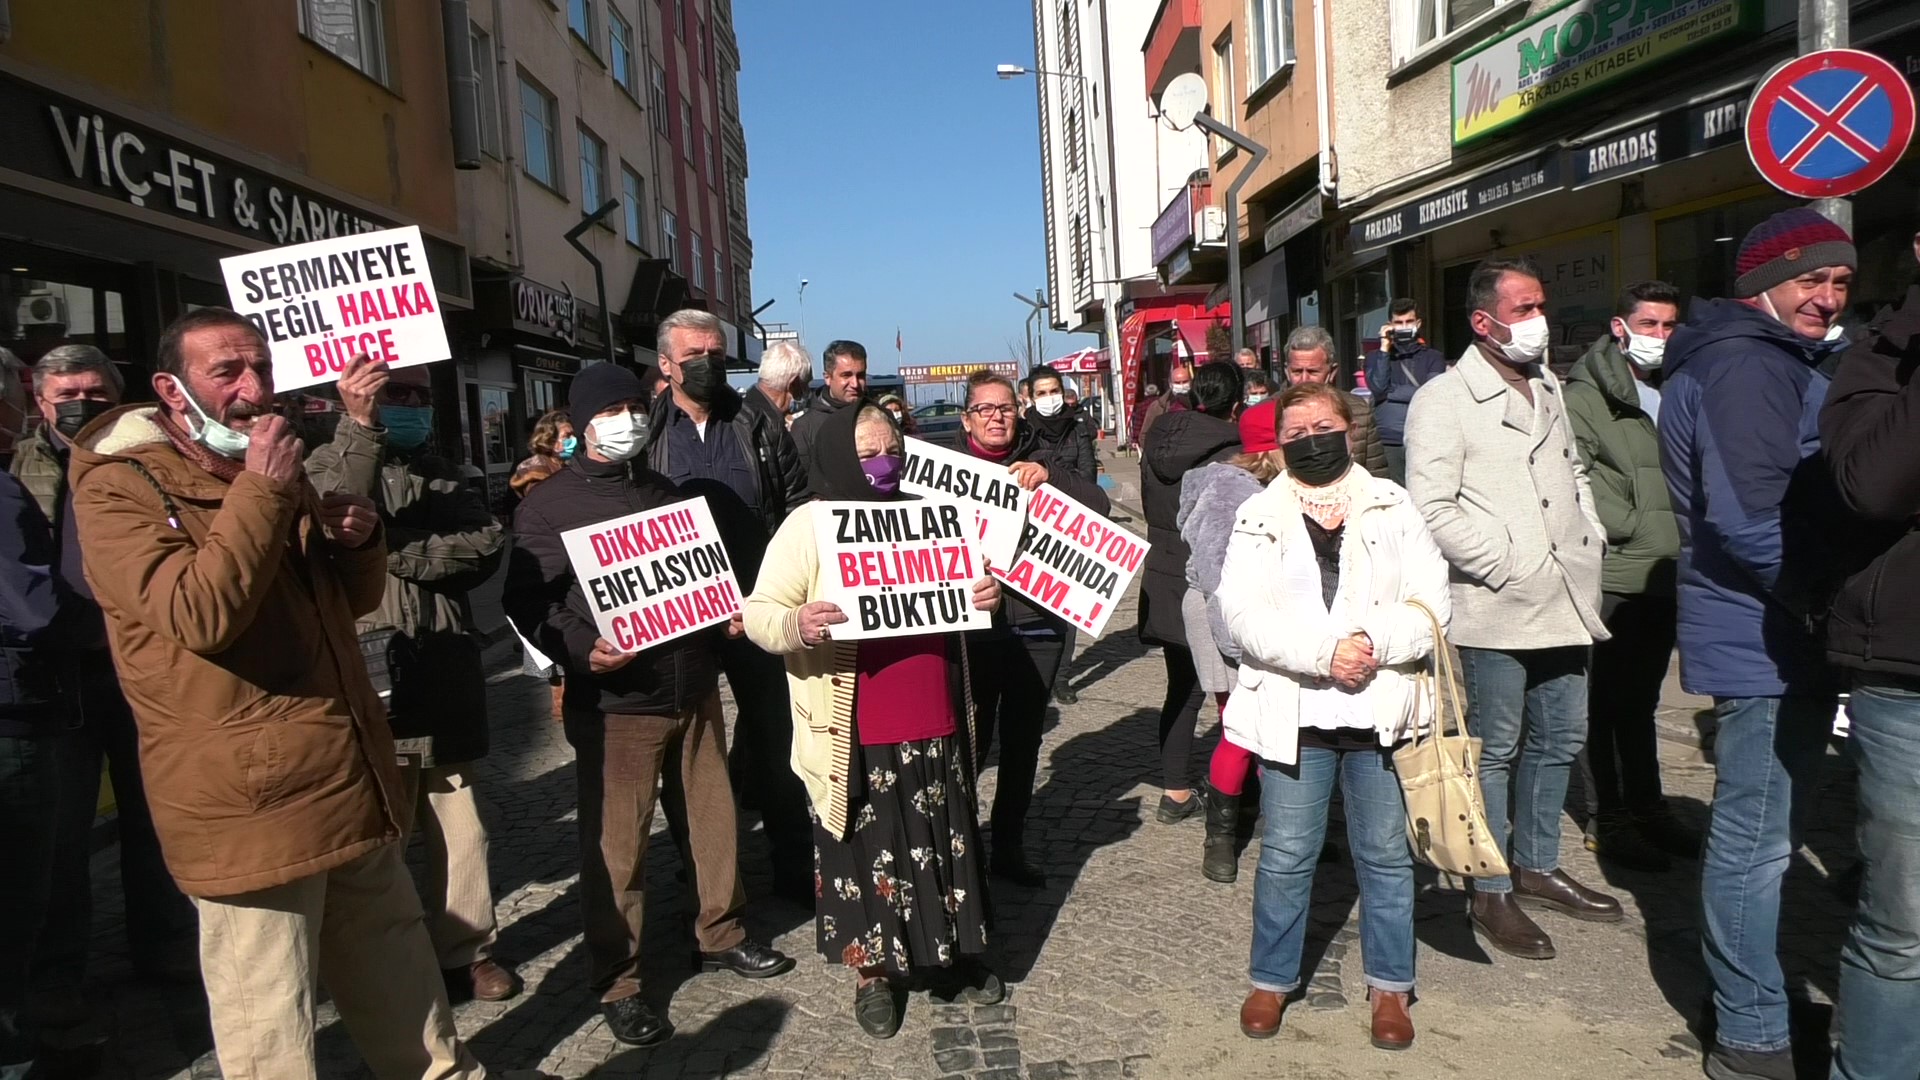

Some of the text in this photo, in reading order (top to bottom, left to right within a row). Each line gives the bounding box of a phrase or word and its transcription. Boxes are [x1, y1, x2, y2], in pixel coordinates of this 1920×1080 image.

[1517, 0, 1692, 79] MOPA
[1518, 37, 1651, 109] ARKADAŞ KİTABEVİ
[1588, 100, 1748, 174] ARKADAŞ KIRT
[233, 177, 260, 231] &
[1365, 212, 1402, 242] ARKADAŞ
[1419, 188, 1469, 225] KIRTASİYE
[241, 242, 416, 304] SERMAYEYE
[336, 281, 435, 328] HALKA
[930, 365, 962, 376] MERKEZ
[900, 451, 1020, 512] MAAŞLAR
[832, 504, 962, 544] ZAMLAR
[1028, 488, 1145, 573] NFLASYON
[588, 541, 730, 613] ENFLASYON
[838, 538, 973, 588] BELİMİZİ
[1021, 522, 1120, 600] RANINDA
[611, 575, 740, 651] CANAVARİ!
[858, 582, 969, 631] BÜKTÜ!
[990, 559, 1103, 629] AM..!
